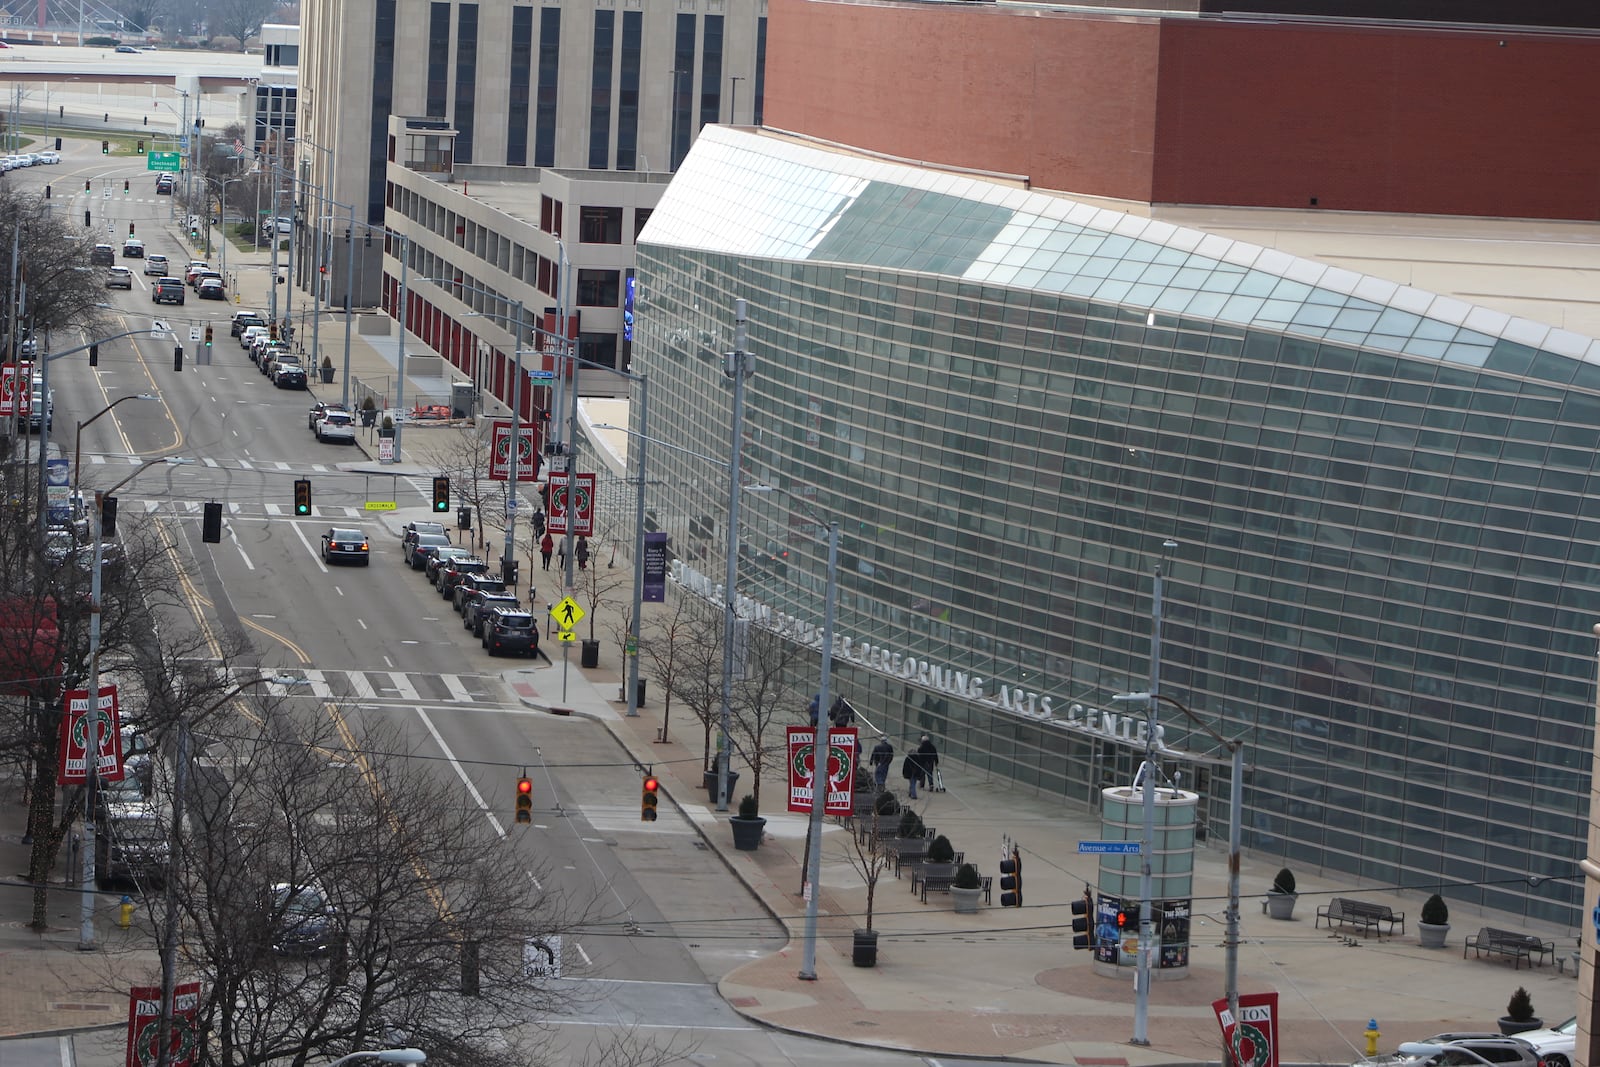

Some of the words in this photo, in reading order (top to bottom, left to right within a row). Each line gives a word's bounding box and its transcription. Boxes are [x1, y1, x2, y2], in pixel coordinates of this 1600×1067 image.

[860, 642, 983, 699] PERFORMING
[998, 684, 1052, 721] ARTS
[1066, 703, 1165, 751] CENTER
[791, 734, 812, 742] DAY
[832, 735, 853, 744] TON
[1080, 843, 1106, 852] Avenue
[1123, 844, 1139, 852] Arts
[1241, 1007, 1269, 1021] TON
